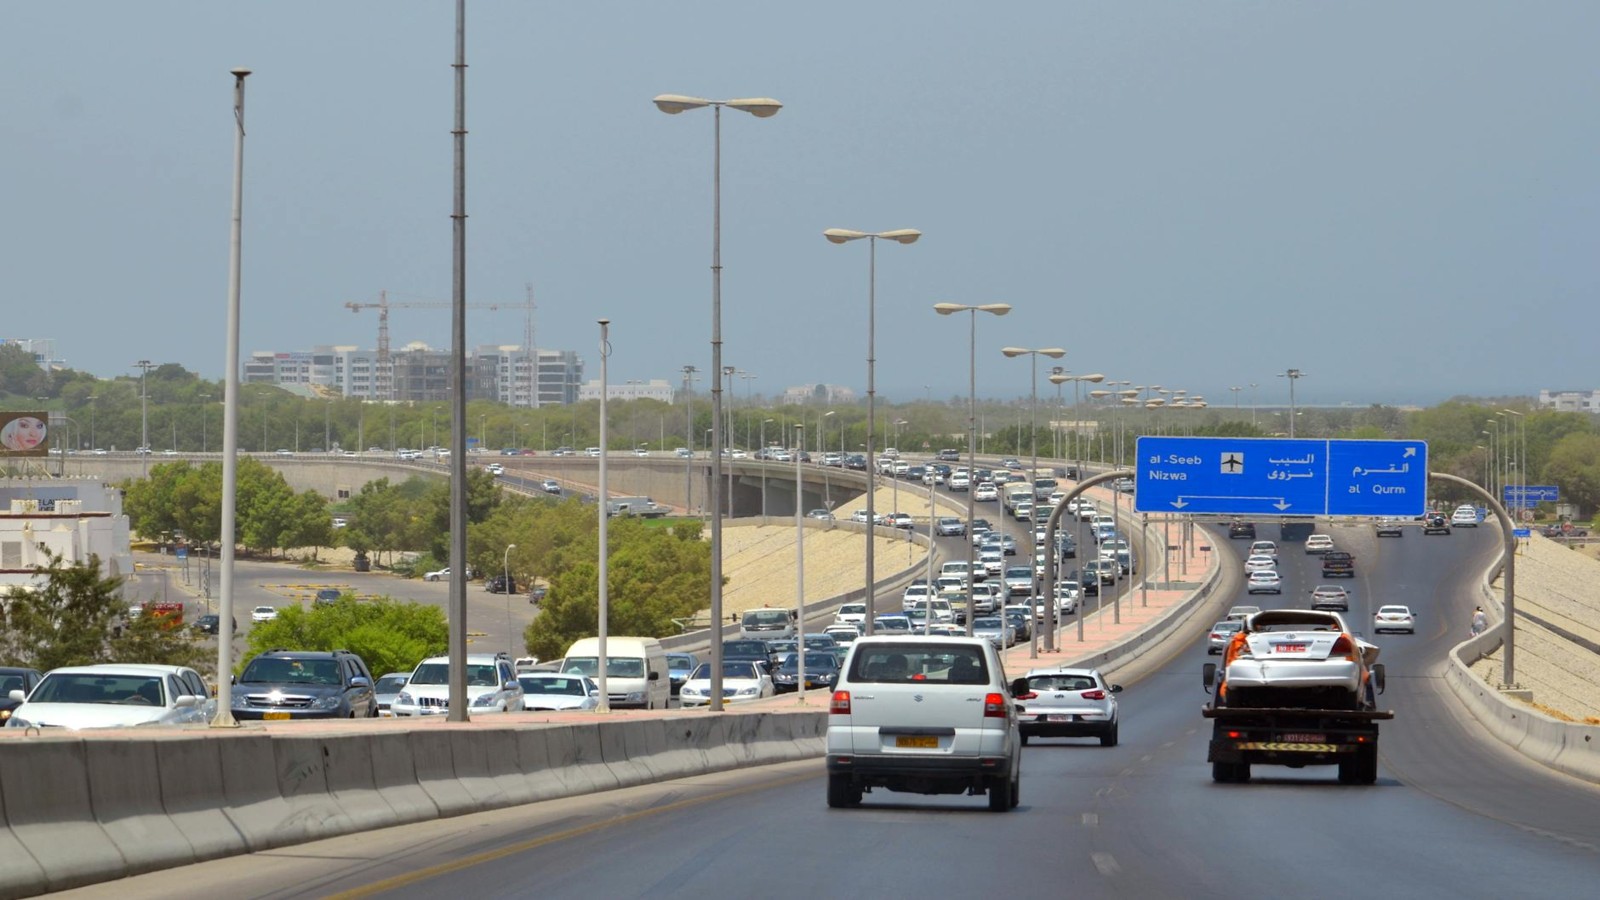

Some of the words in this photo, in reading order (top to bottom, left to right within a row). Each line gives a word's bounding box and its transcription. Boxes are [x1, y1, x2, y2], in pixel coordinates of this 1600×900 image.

[1150, 455, 1160, 464] al
[1268, 454, 1314, 466] السيب
[1149, 470, 1187, 480] Nizwa
[1352, 463, 1410, 478] القرم
[1348, 484, 1360, 494] al
[1372, 484, 1406, 494] Qurm
